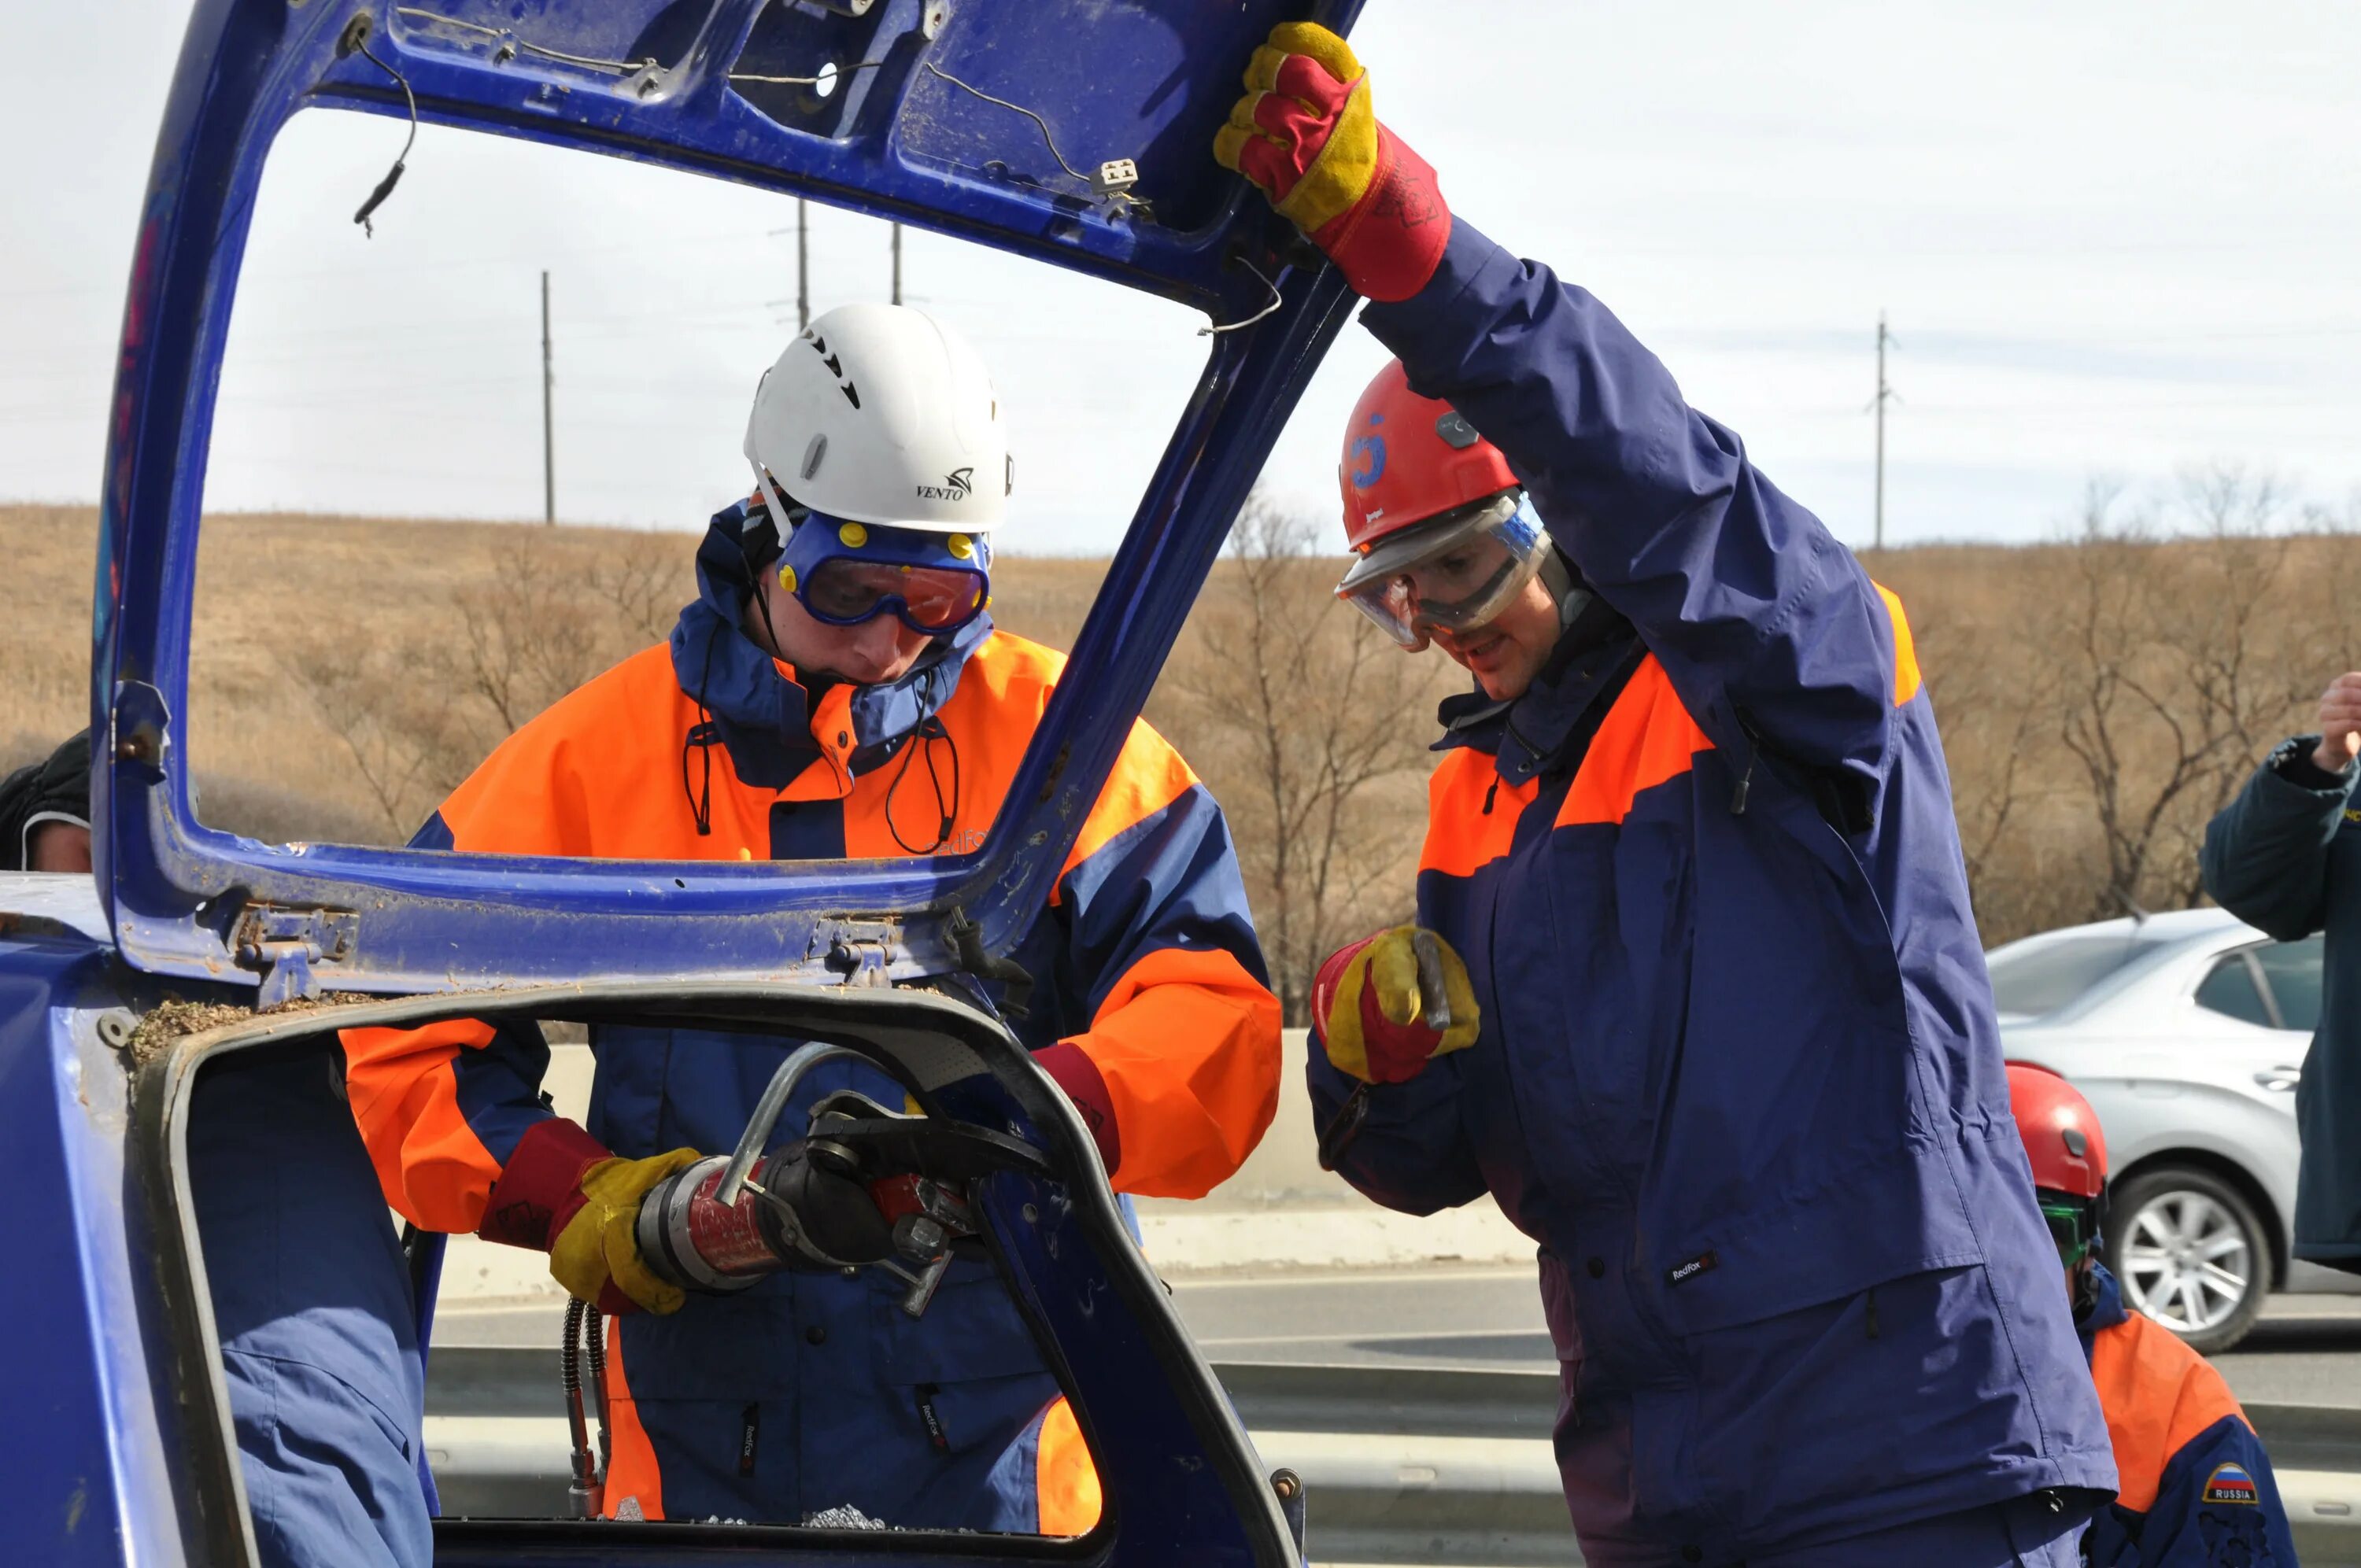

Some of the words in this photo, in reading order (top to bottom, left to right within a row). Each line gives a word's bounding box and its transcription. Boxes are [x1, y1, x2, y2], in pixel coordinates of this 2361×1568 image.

[916, 485, 963, 501] VENTO
[1672, 1261, 1701, 1281] RedFox
[2216, 1489, 2251, 1500] RUSSIA
